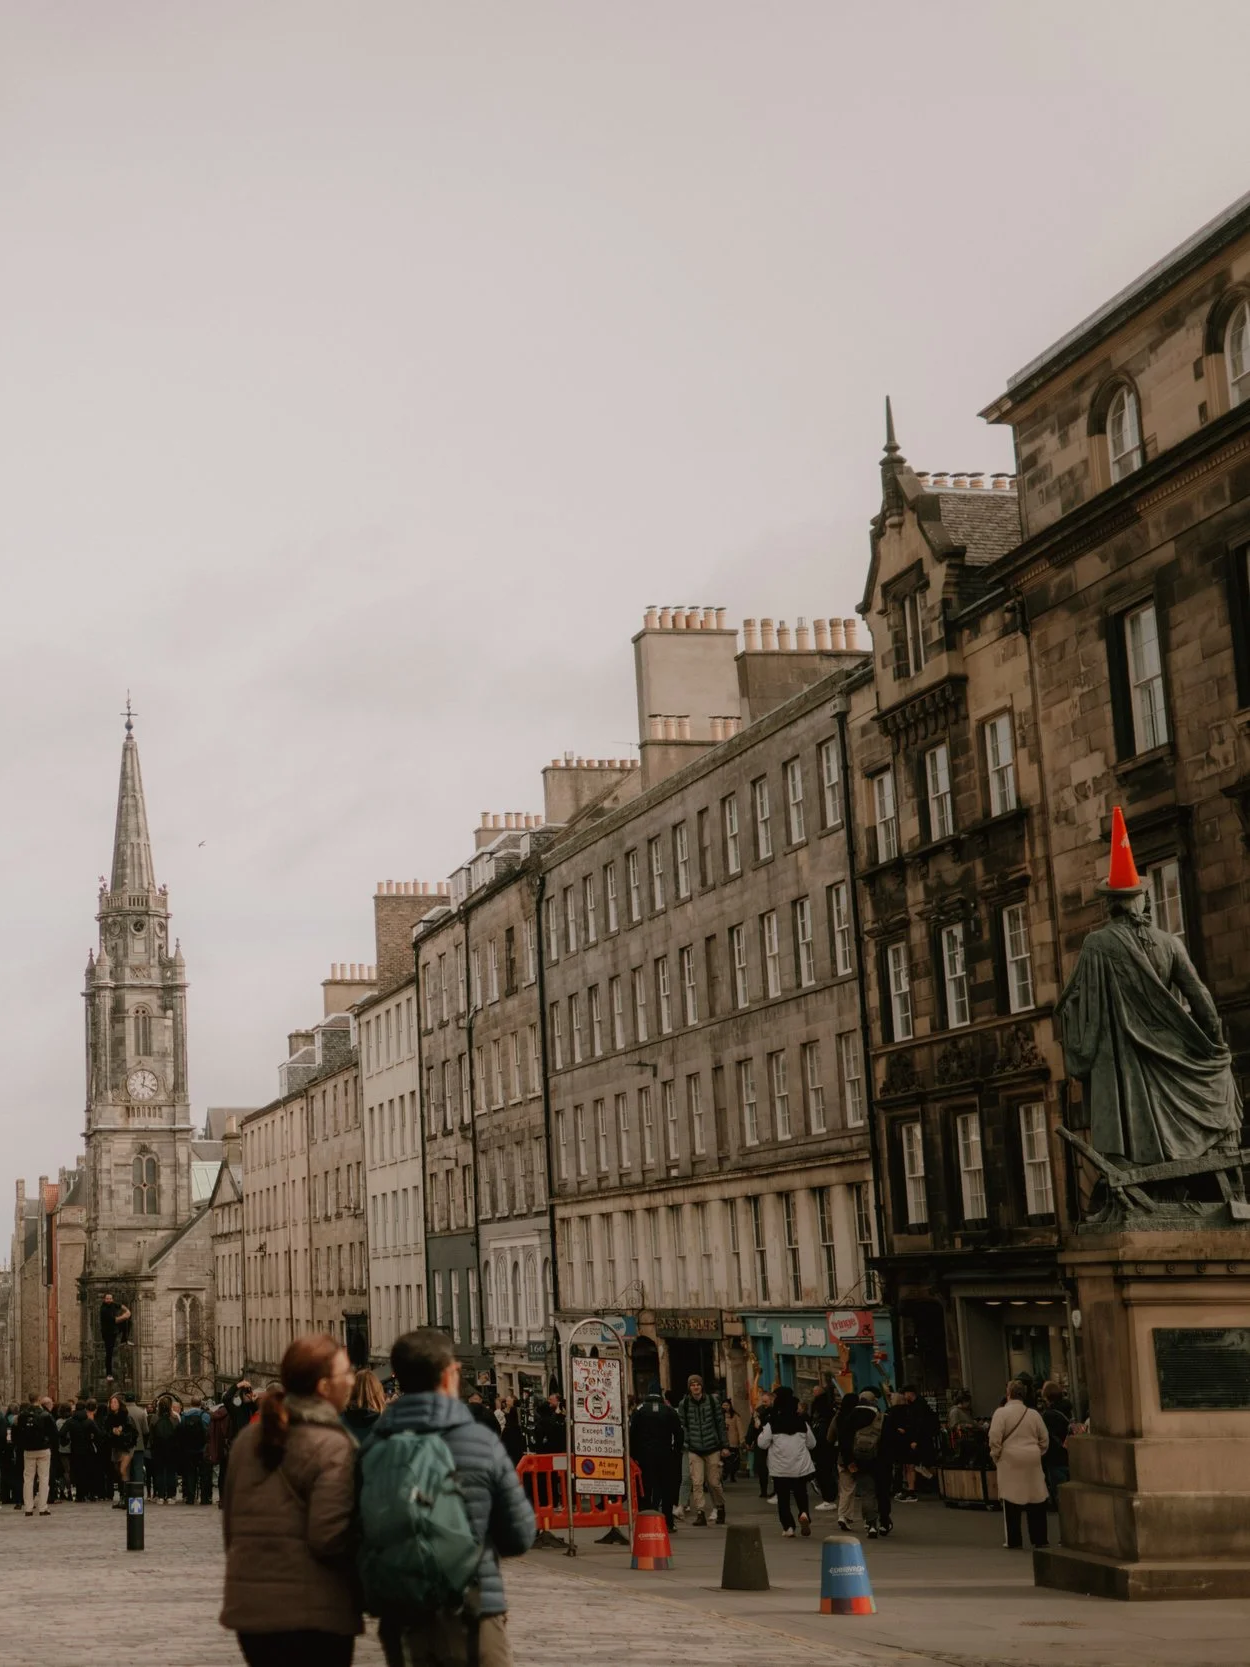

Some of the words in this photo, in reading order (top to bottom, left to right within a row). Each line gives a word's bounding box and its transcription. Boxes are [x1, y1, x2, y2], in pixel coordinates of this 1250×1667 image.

[831, 1319, 858, 1331] fringe
[530, 1344, 544, 1353] 166
[574, 1359, 617, 1368] DESIAN
[582, 1426, 603, 1435] Except
[594, 1438, 616, 1446] loading
